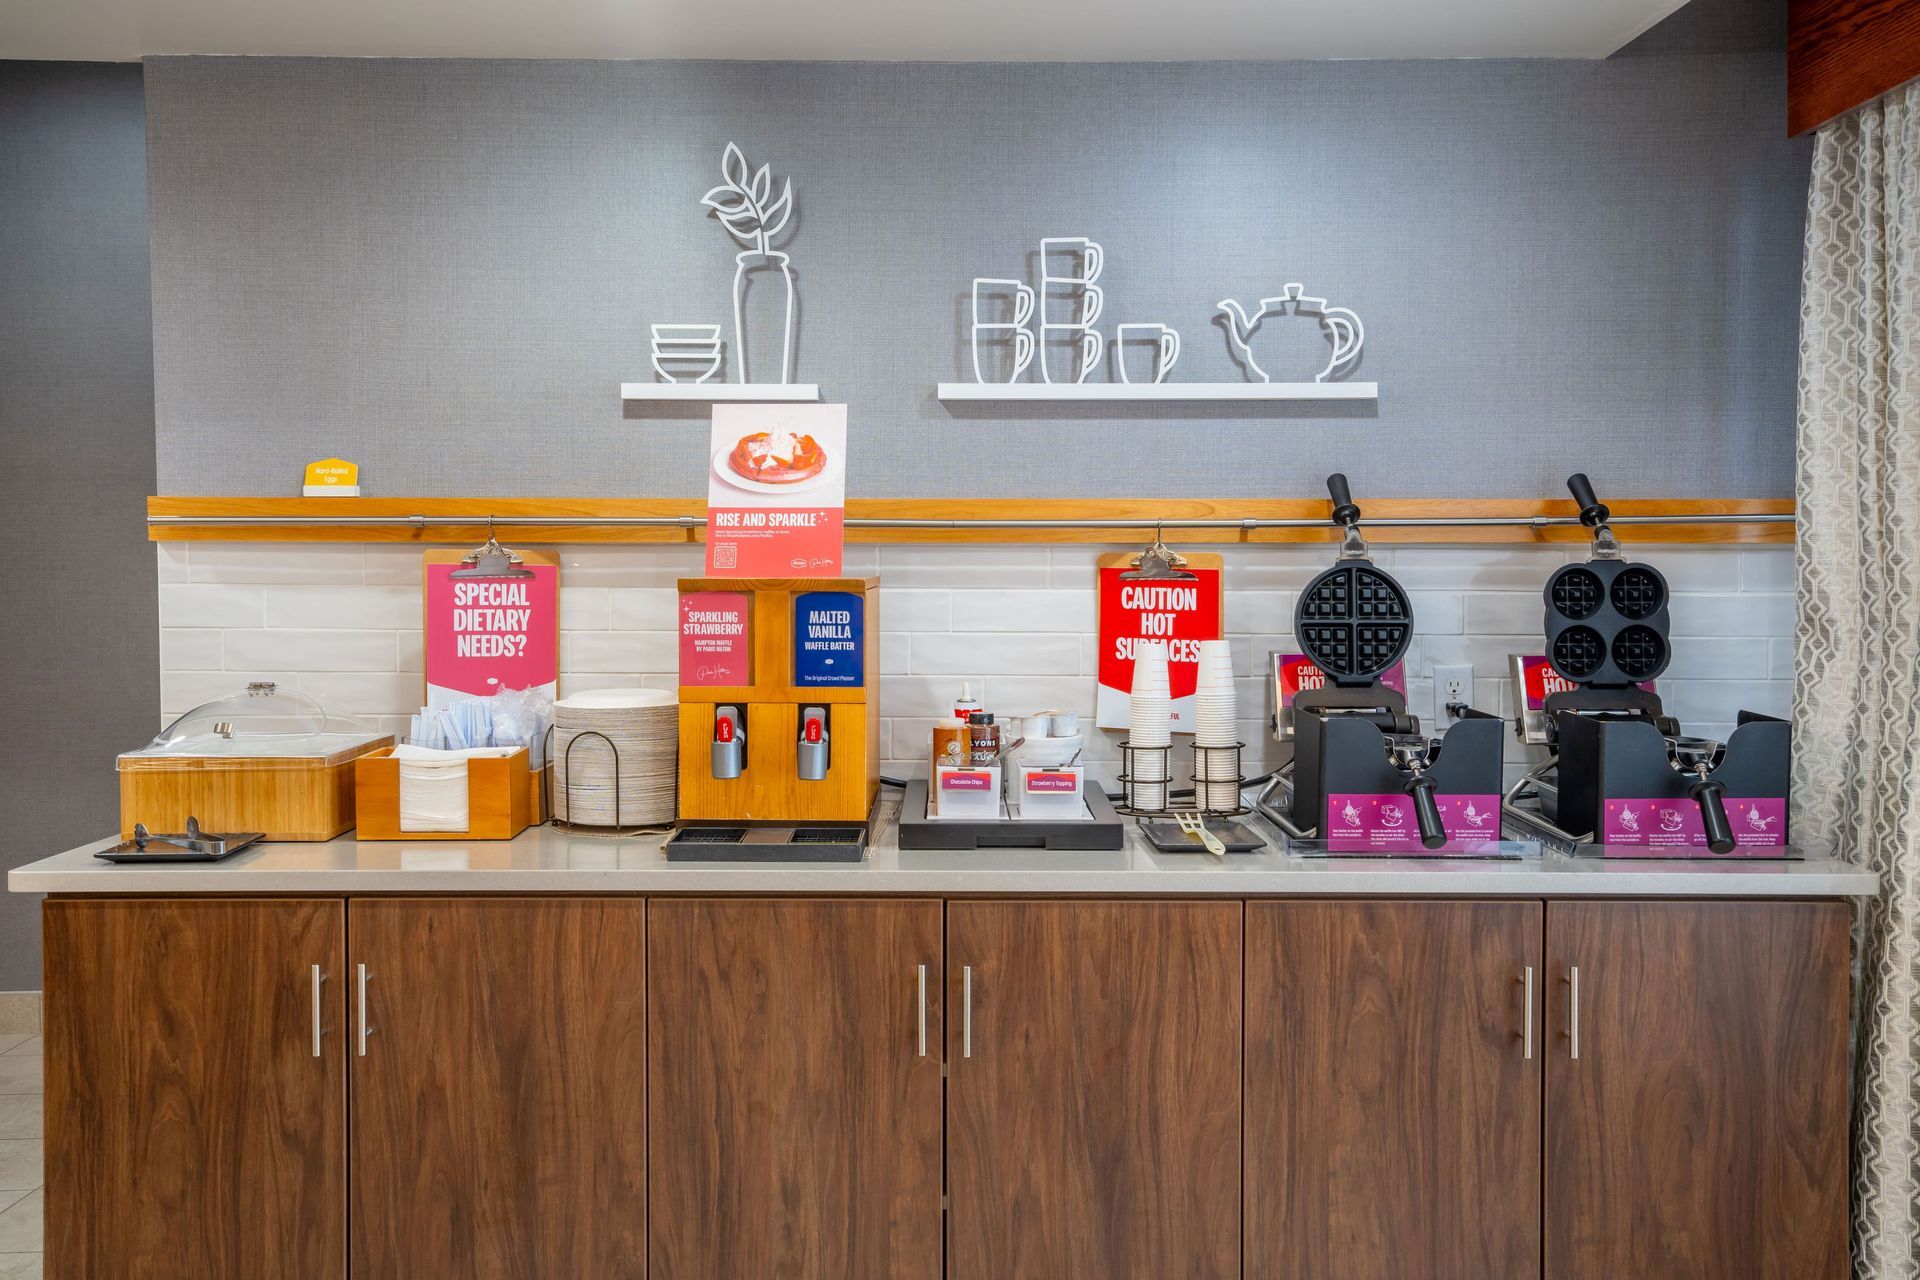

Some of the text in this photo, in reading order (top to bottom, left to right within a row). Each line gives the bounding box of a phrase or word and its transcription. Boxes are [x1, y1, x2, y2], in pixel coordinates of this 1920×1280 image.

[716, 512, 817, 527] RISE AND SPARKLE
[454, 583, 530, 606] SPECIAL
[1121, 586, 1197, 611] CAUTION
[453, 608, 531, 632] DIETARY
[688, 611, 738, 623] SPARKLING
[809, 610, 851, 624] MALTED
[1140, 612, 1176, 636] HOT
[683, 623, 743, 635] STRAWBERRY
[808, 625, 852, 639] VANILLA
[457, 634, 527, 657] NEEDS?
[804, 641, 855, 651] WAFFLE BATTER
[1055, 780, 1072, 788] Topping
